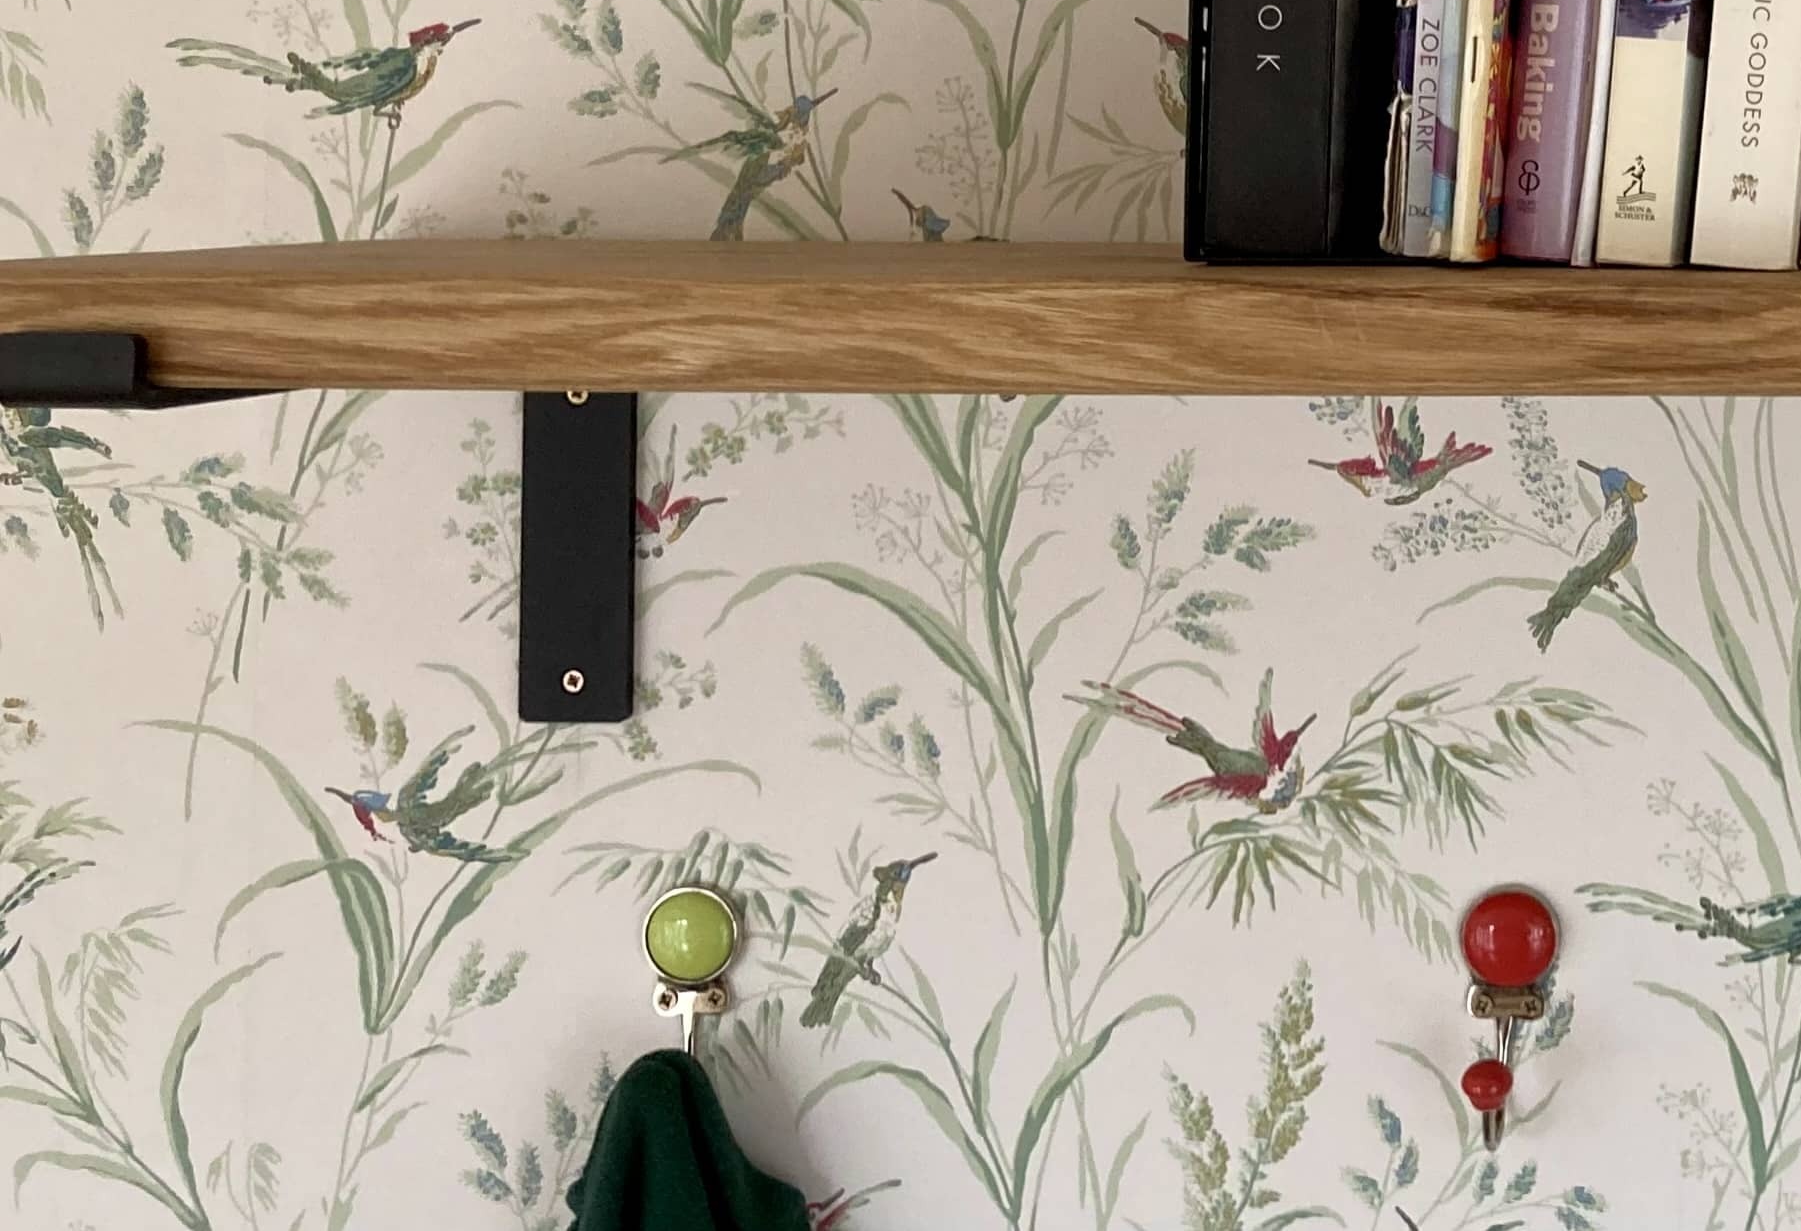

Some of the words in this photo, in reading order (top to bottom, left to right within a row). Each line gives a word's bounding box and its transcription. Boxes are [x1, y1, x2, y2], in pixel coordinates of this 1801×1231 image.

[1419, 18, 1440, 67] ZOE
[1516, 4, 1559, 142] Baking
[1741, 32, 1768, 148] GODDESS
[1415, 78, 1438, 153] CLARK
